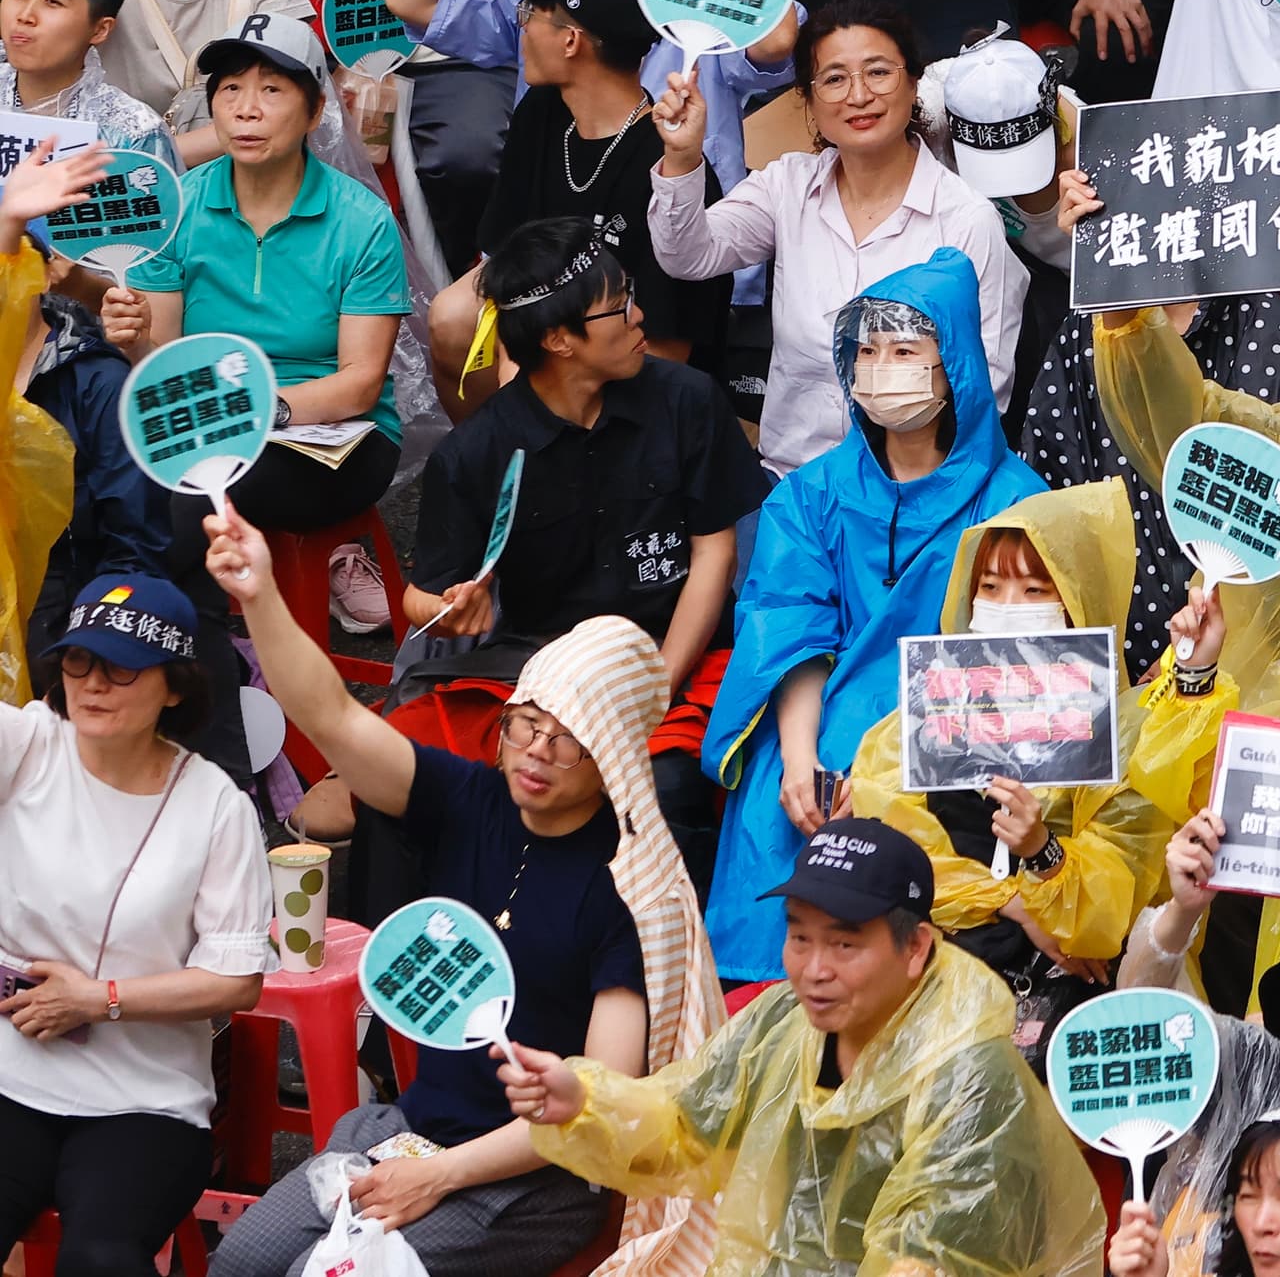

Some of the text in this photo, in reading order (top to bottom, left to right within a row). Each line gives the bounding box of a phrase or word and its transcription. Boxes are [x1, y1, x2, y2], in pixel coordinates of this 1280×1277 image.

[240, 15, 271, 42] R
[1189, 439, 1273, 501] 我藐視
[1065, 1021, 1163, 1059] 我藐視
[1066, 1052, 1195, 1092] 藍白黑箱
